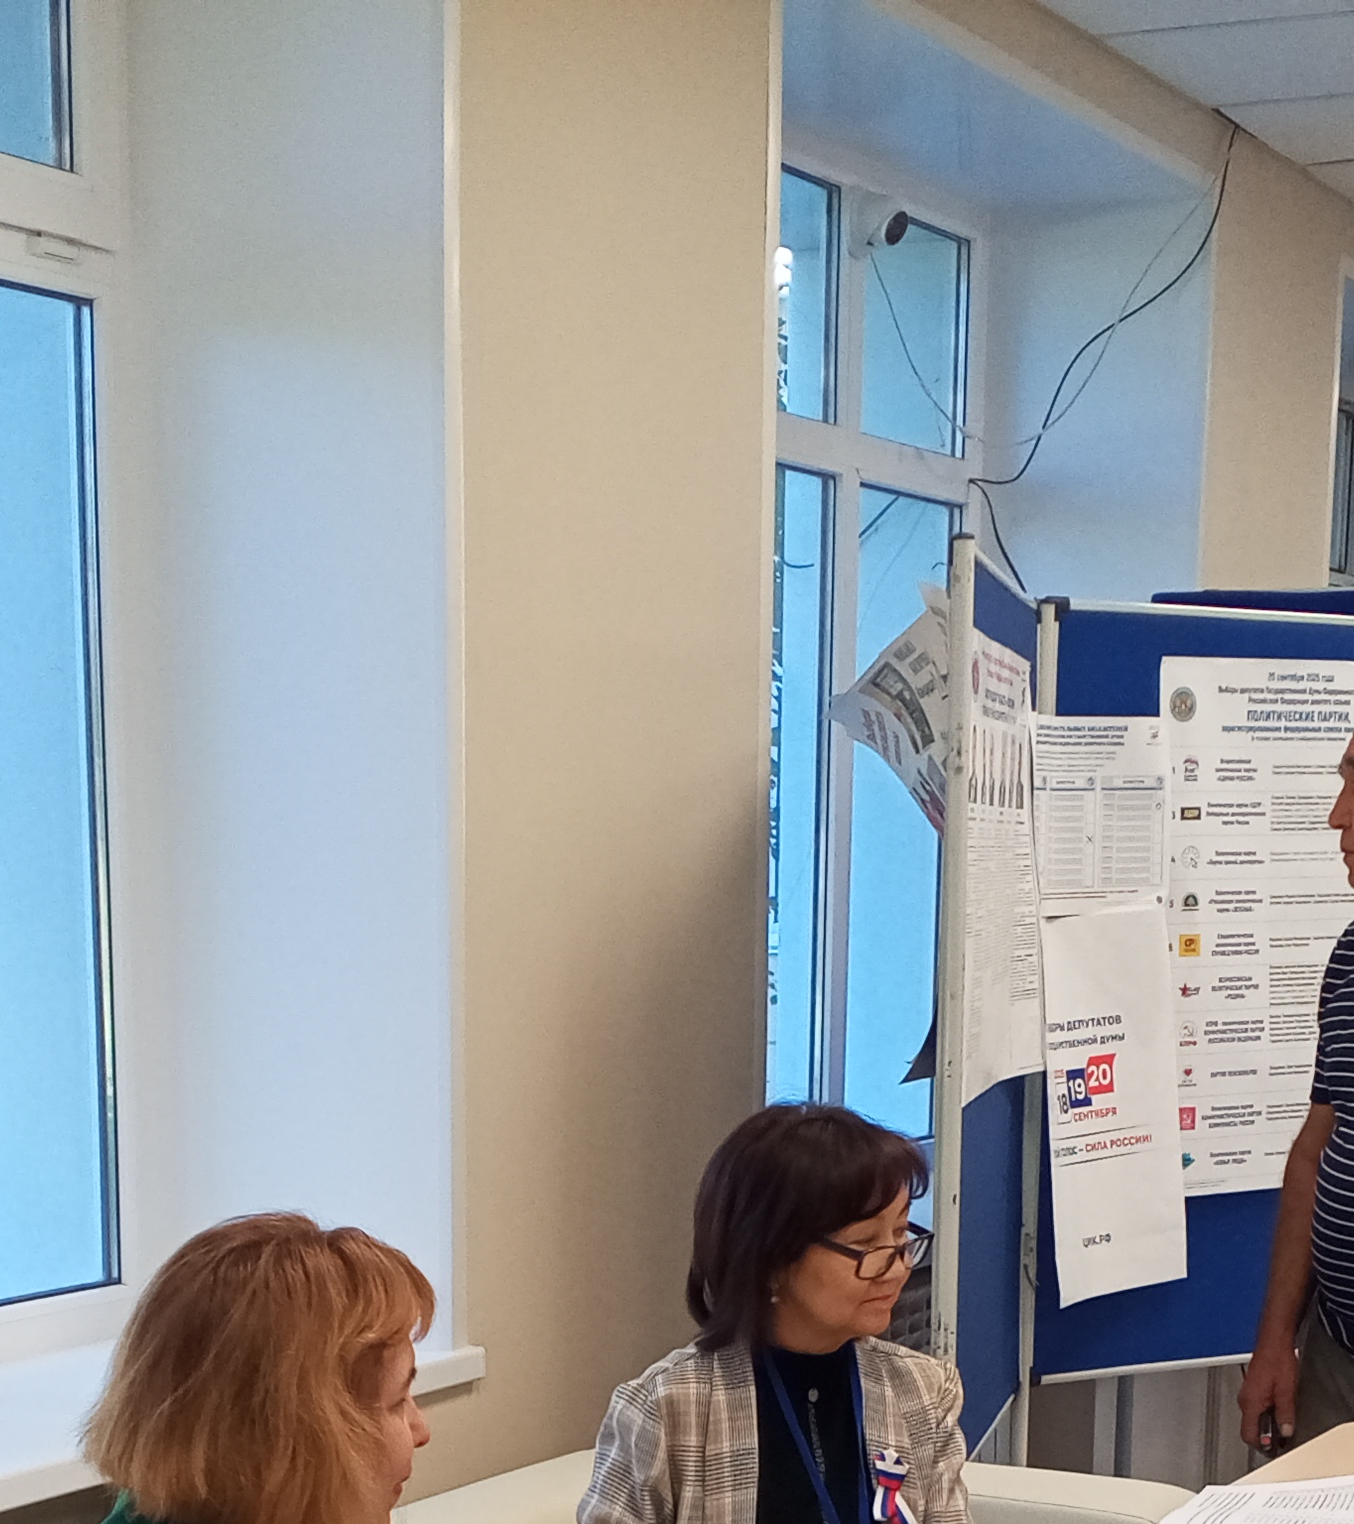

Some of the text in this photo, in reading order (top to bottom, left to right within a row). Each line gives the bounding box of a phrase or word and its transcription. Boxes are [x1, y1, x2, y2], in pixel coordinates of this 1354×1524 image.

[1247, 710, 1315, 722] ПОЛИТИЧЕСКИЕ
[1066, 1015, 1122, 1032] ДЕПУТАТОВ
[1099, 1033, 1125, 1045] ДУМЫ
[1057, 1063, 1111, 1115] 18 19 20
[1073, 1106, 1118, 1123] СЕНТЯБРЯ
[1085, 1139, 1108, 1153] СИЛА
[1110, 1134, 1152, 1150] РОССИИ!
[1083, 1233, 1112, 1248] ЦИК.РФ
